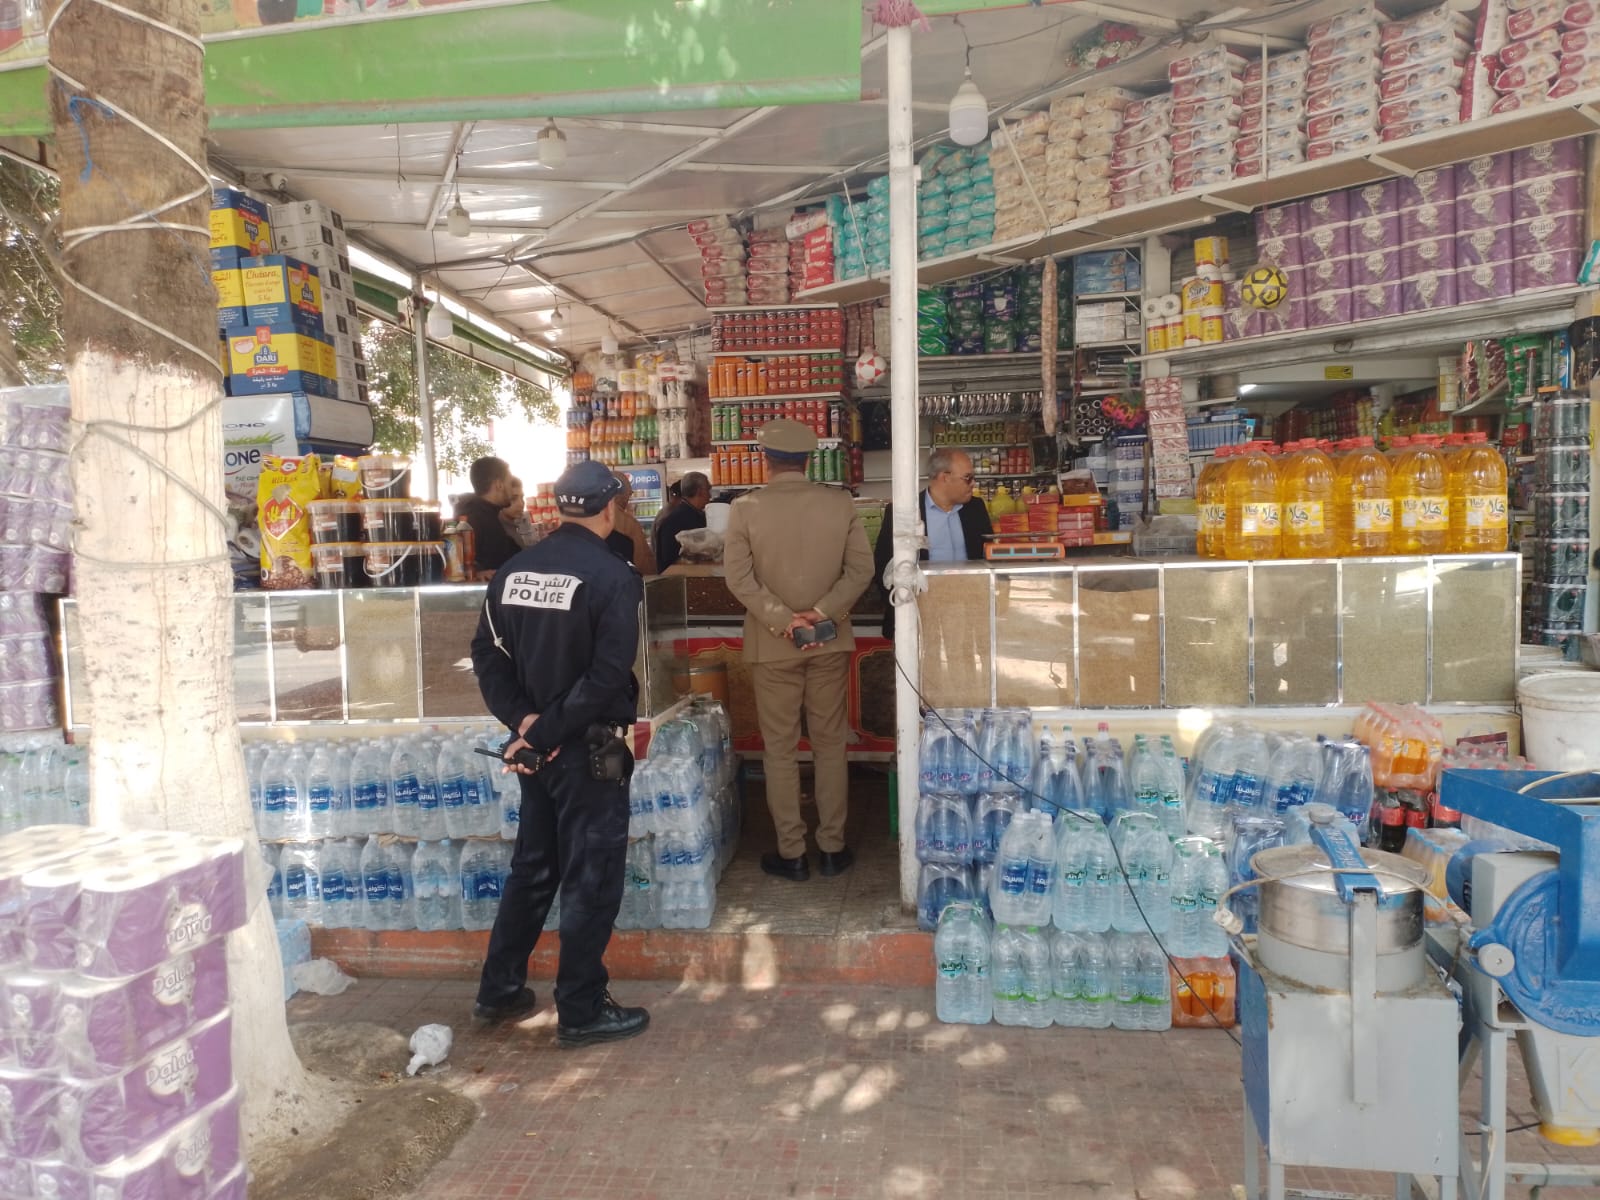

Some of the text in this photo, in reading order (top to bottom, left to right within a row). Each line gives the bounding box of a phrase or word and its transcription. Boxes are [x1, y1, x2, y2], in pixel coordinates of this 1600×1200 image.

[635, 474, 659, 485] pepsi
[514, 574, 572, 590] الشرطة
[509, 588, 566, 604] POLICE
[152, 961, 196, 996] Dalaa
[146, 1048, 195, 1086] Dalaa
